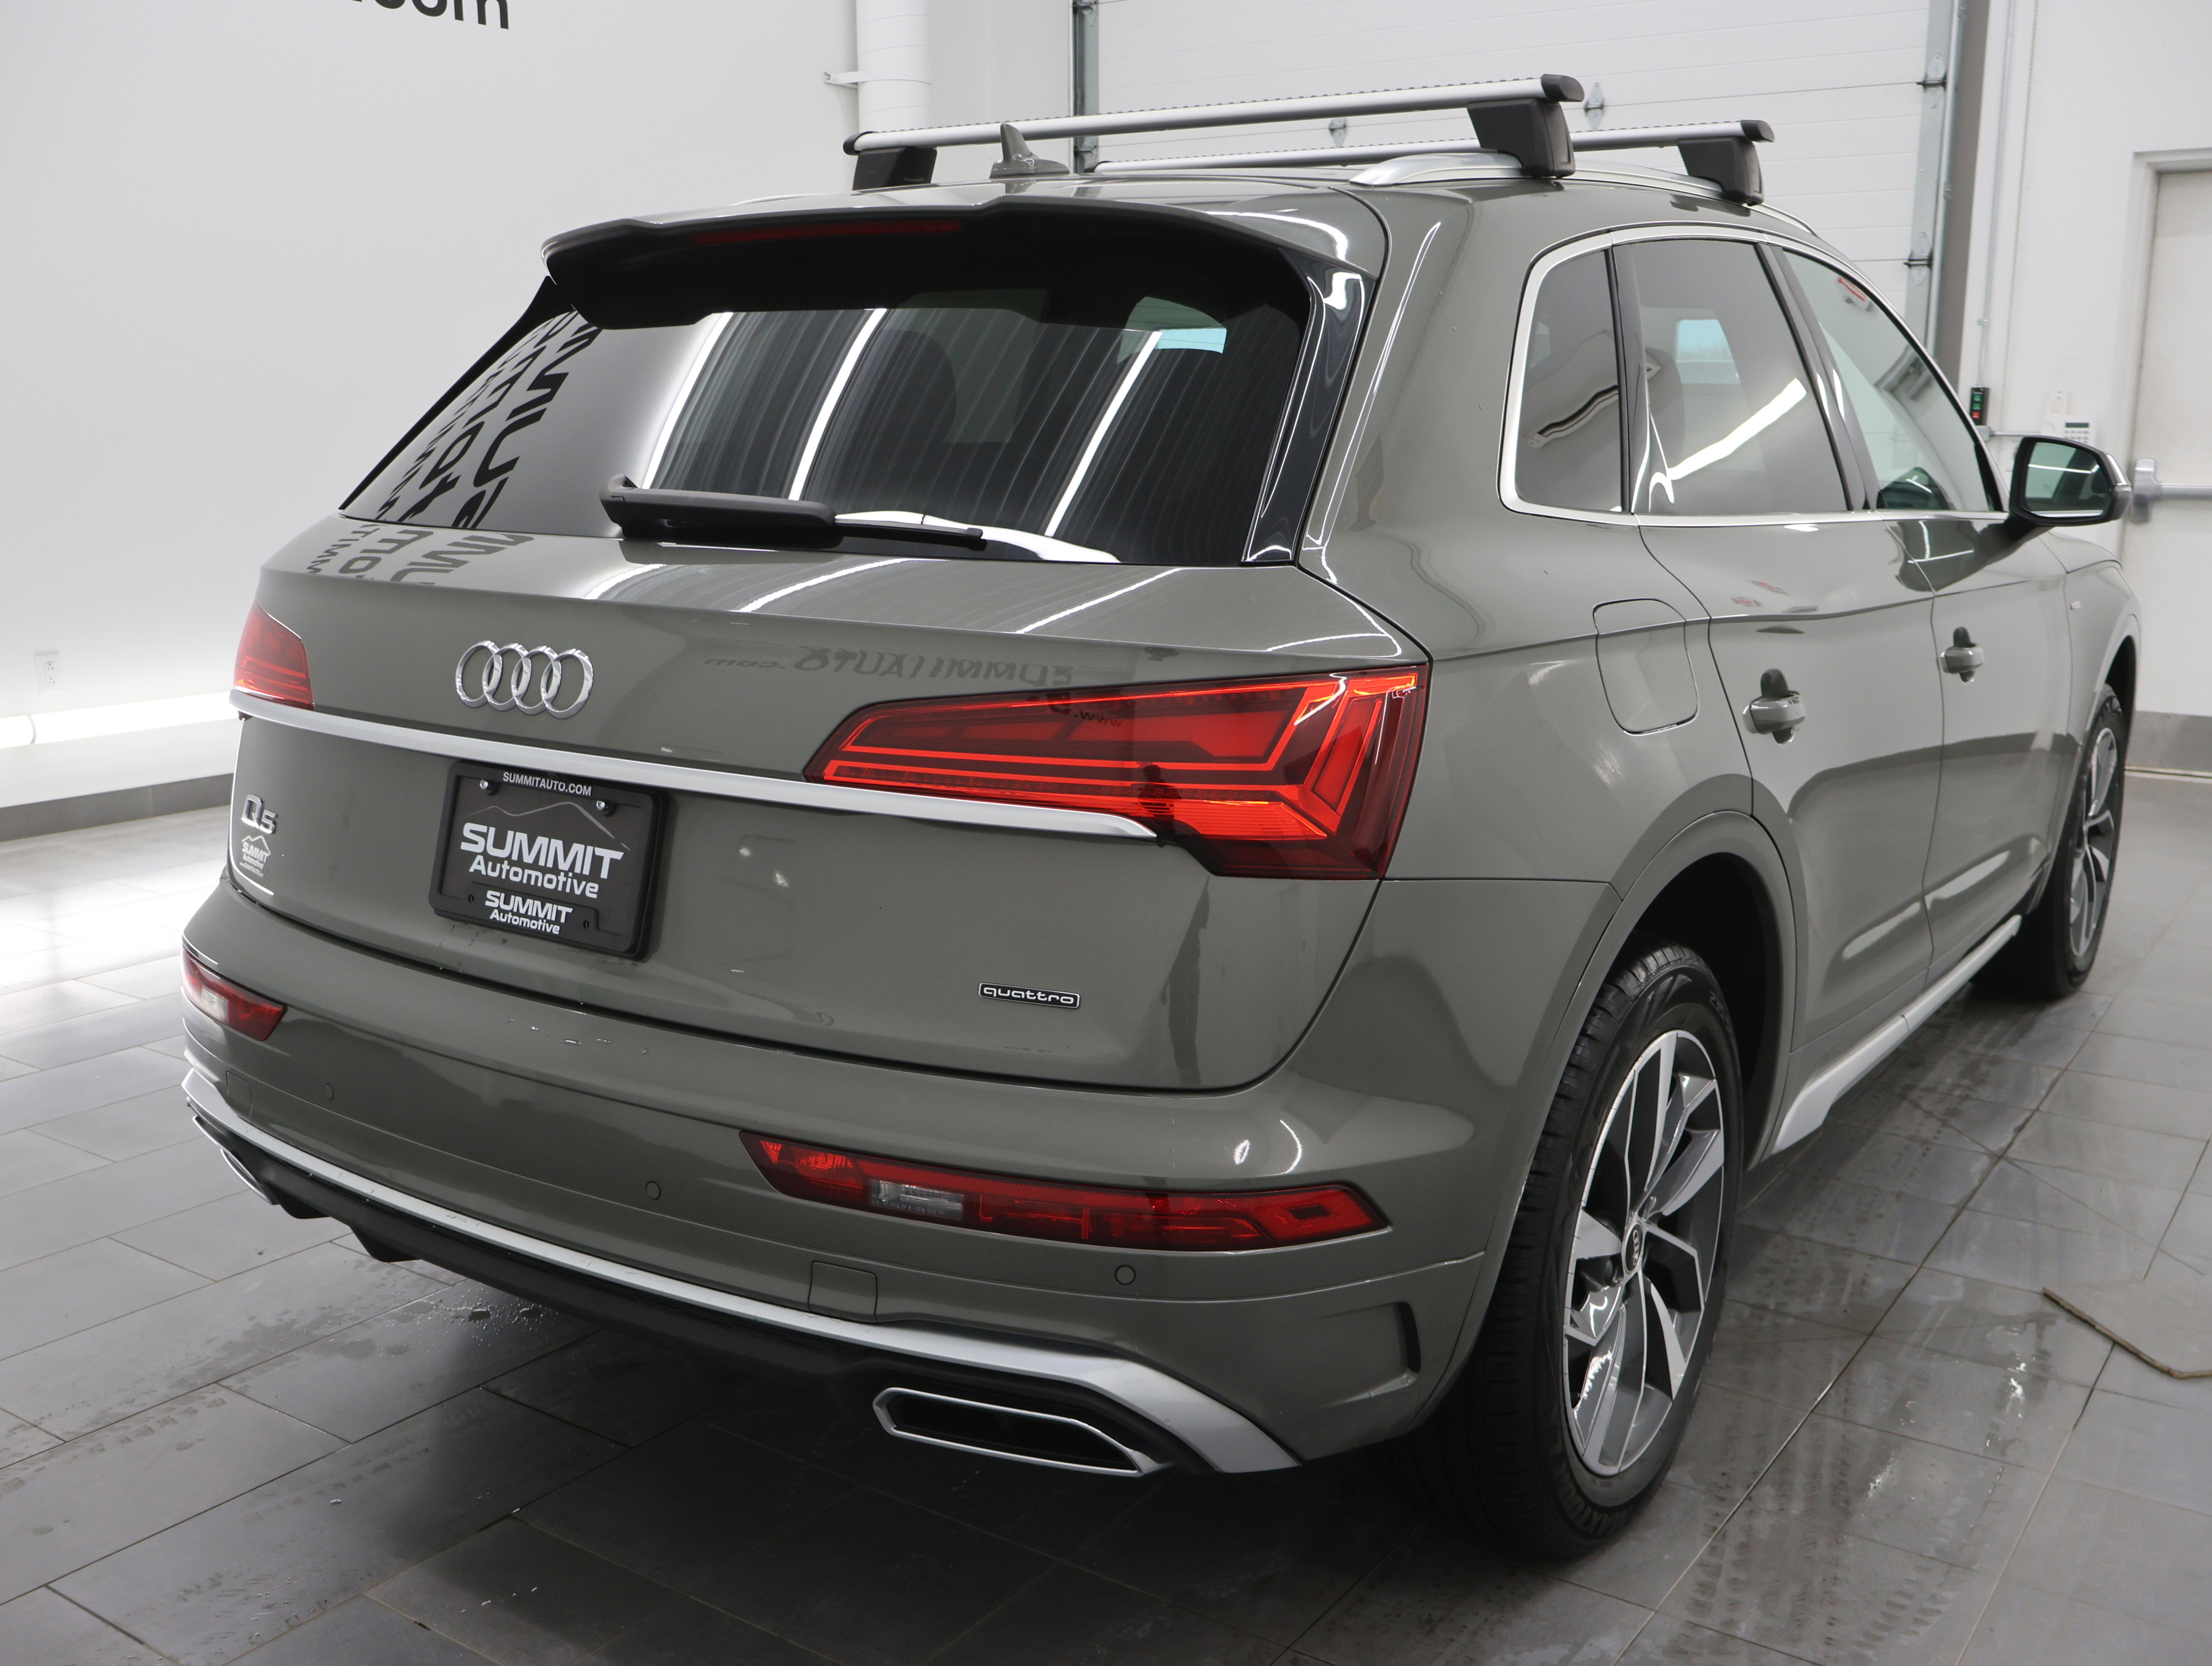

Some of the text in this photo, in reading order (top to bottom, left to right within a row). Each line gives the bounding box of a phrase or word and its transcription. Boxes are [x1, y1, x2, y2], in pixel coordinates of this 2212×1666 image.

[503, 772, 592, 796] SUMMITAUTO.COM
[241, 794, 277, 834] Q5
[242, 841, 270, 863] SUMMIT
[461, 823, 624, 879] SUMMIT
[469, 855, 599, 899] Automotive
[485, 890, 573, 923] SUMMIT
[490, 909, 560, 934] Automotive
[984, 987, 1074, 1004] quattro
